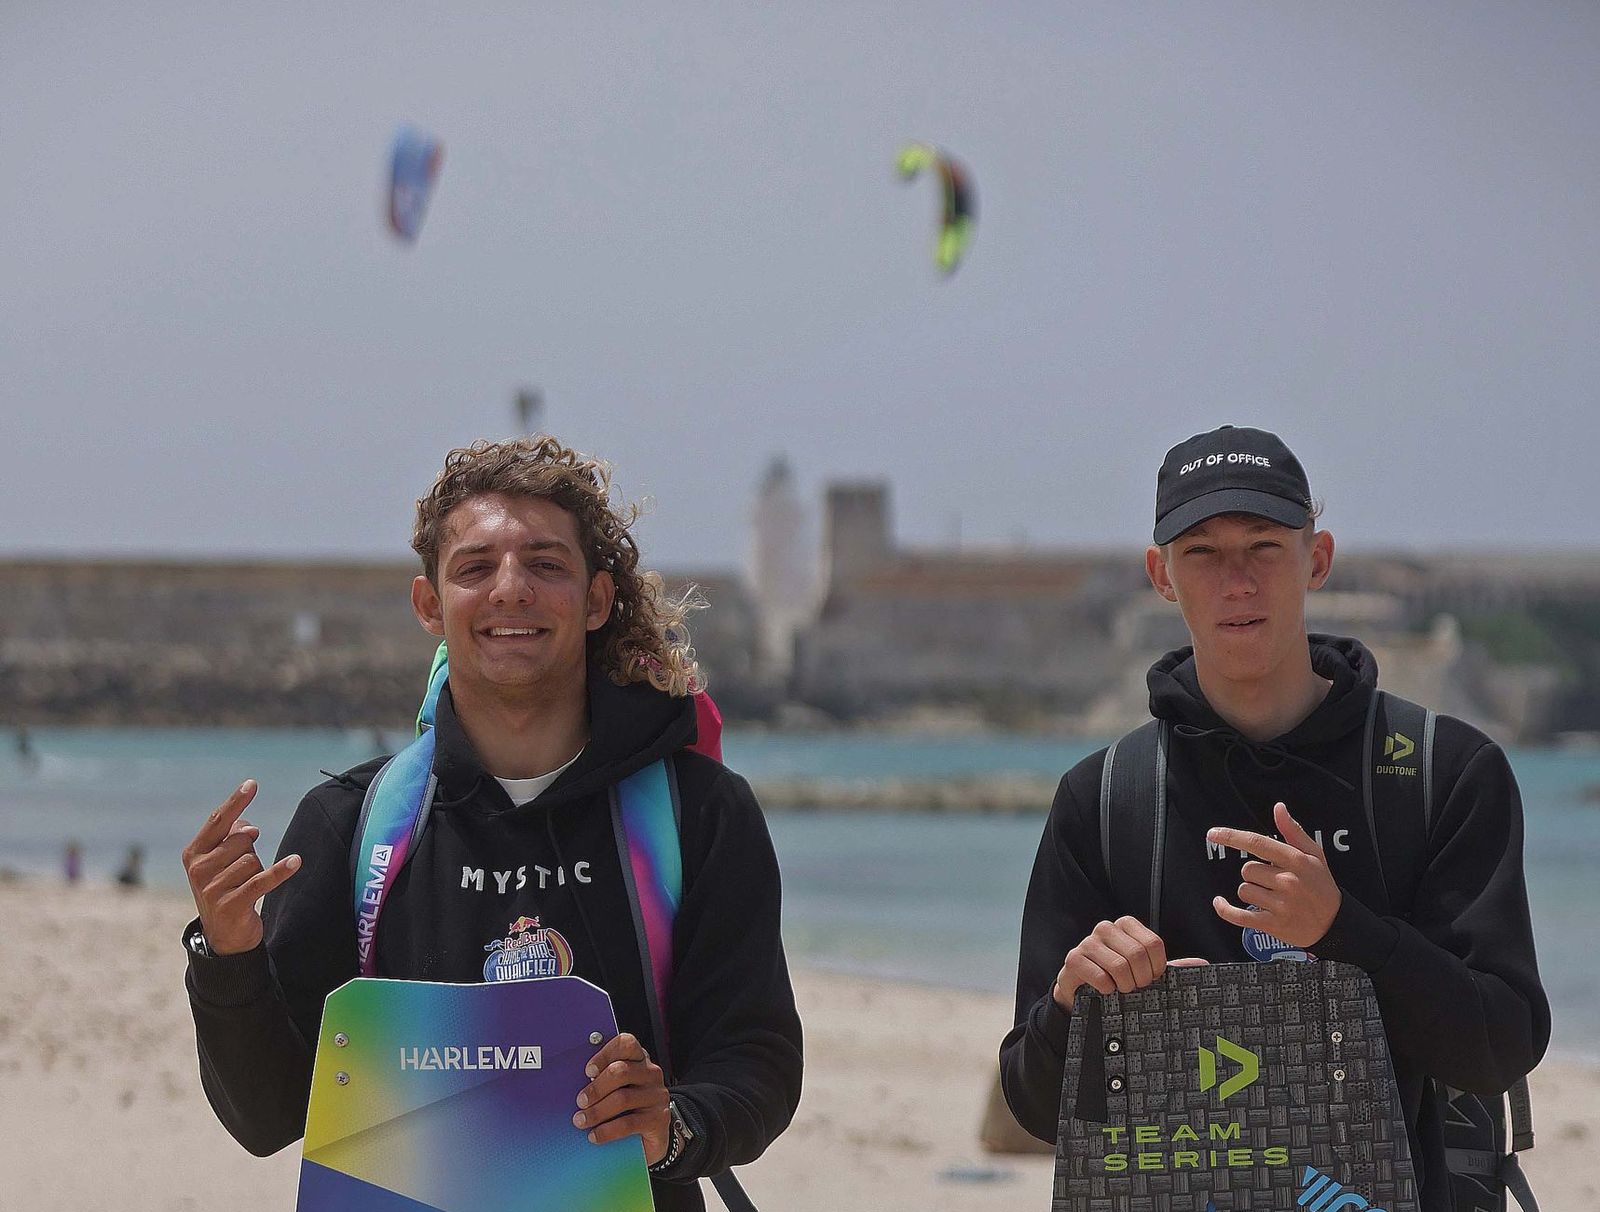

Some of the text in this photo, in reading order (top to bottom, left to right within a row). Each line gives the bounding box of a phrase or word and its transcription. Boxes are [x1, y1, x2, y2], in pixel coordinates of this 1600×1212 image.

[1180, 453, 1271, 475] OUT OF OFFICE
[1376, 765, 1417, 776] DUOTONE
[1206, 829, 1350, 860] MIC
[461, 861, 592, 894] MYSTIC
[522, 929, 546, 945] Bull
[496, 959, 556, 981] QUALIFIER
[400, 1046, 516, 1071] HARLEM
[1102, 1122, 1242, 1145] TEAM
[1102, 1147, 1289, 1172] SERIES
